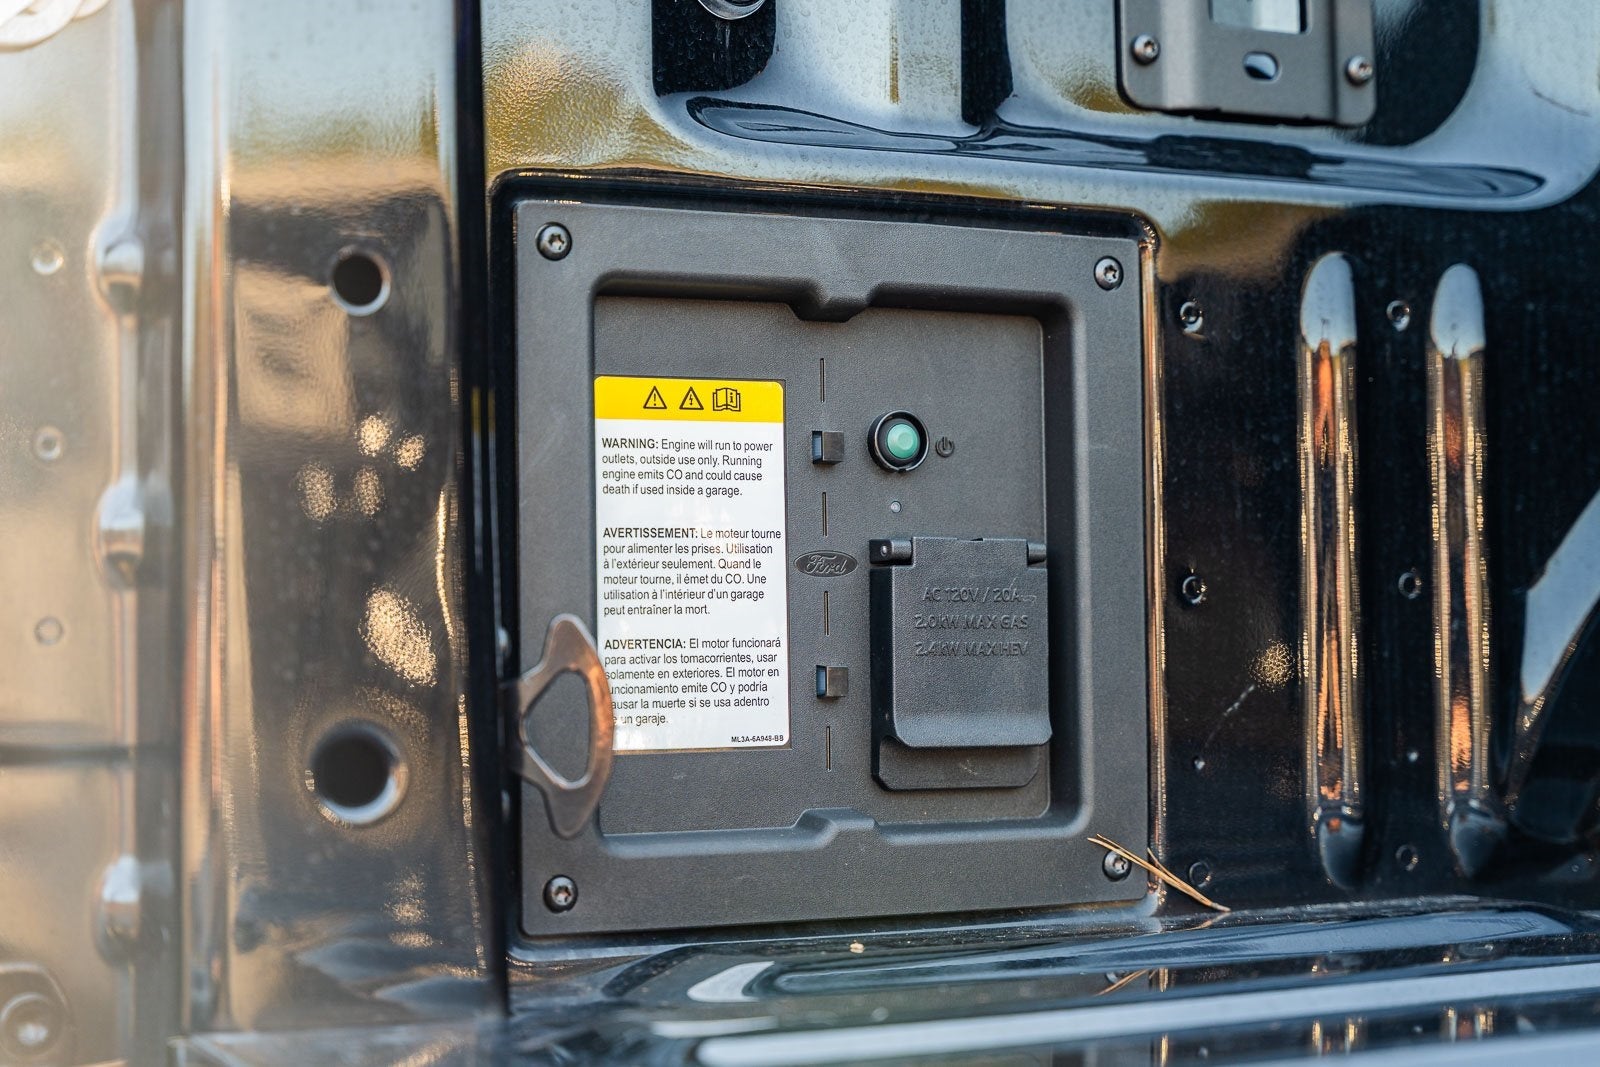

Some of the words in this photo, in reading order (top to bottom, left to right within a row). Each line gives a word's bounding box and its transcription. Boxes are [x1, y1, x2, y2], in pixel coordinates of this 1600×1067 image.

[602, 438, 658, 449] WARNING:
[662, 439, 695, 452] Engine
[698, 440, 712, 450] will
[733, 442, 742, 450] to
[744, 443, 773, 452] power
[602, 454, 638, 465] outlets,
[640, 454, 675, 464] outside
[678, 457, 695, 465] use
[698, 455, 720, 467] only.
[722, 456, 762, 468] Running
[602, 470, 635, 481] engine
[638, 469, 664, 480] emits
[666, 470, 682, 480] CO
[685, 470, 703, 480] and
[706, 470, 731, 480] could
[734, 472, 762, 481] cause
[603, 484, 630, 494] death
[632, 484, 638, 494] if
[641, 484, 664, 495] used
[666, 485, 694, 495] inside
[697, 487, 703, 495] a
[706, 487, 742, 498] garage.
[603, 528, 698, 538] AVERTISSEMENT:
[701, 528, 712, 538] Le
[715, 529, 749, 538] moteur
[752, 529, 781, 538] tourne
[603, 545, 625, 555] pour
[628, 544, 672, 554] alimenter
[675, 544, 689, 553] les
[692, 544, 723, 556] prises.
[726, 544, 772, 554] Utilisation
[604, 559, 609, 569] à
[662, 559, 715, 569] seulement.
[718, 559, 750, 569] Quand
[753, 559, 761, 569] le
[806, 554, 847, 575] Ford
[604, 575, 637, 584] moteur
[640, 575, 674, 586] tourne,
[676, 574, 681, 584] il
[684, 574, 708, 584] émet
[711, 574, 722, 584] du
[725, 574, 744, 584] CO.
[747, 574, 766, 584] Une
[604, 589, 649, 599] utilisation
[652, 589, 658, 599] à
[708, 589, 728, 599] d'un
[731, 590, 764, 601] garage
[922, 587, 940, 602] AC
[945, 587, 978, 602] 120V
[993, 588, 1020, 602] 20A
[604, 606, 625, 617] peut
[628, 604, 672, 615] entraîner
[674, 604, 682, 614] la
[685, 605, 710, 614] mort.
[963, 614, 997, 629] MAX
[1000, 615, 1029, 629] GAS
[605, 639, 685, 649] ADVERTENCIA:
[690, 638, 698, 648] El
[702, 639, 729, 648] motor
[732, 637, 781, 648] funcionará
[963, 641, 997, 656] MAX
[999, 641, 1029, 656] HEV
[605, 656, 626, 666] para
[629, 654, 660, 664] activar
[663, 654, 677, 664] los
[680, 653, 754, 664] tomacorrientes,
[756, 654, 777, 662] usar
[606, 670, 654, 679] solamente
[658, 670, 669, 678] en
[673, 668, 722, 678] exteriores.
[726, 667, 735, 677] El
[738, 668, 766, 677] motor
[768, 668, 779, 676] en
[610, 684, 678, 695] uncionamiento
[682, 683, 707, 693] emite
[710, 682, 726, 692] CO
[729, 684, 735, 694] y
[738, 681, 767, 693] podría
[612, 700, 637, 709] ausar
[641, 699, 649, 708] la
[652, 698, 685, 708] muerte
[689, 698, 697, 707] si
[714, 698, 731, 707] usa
[734, 696, 769, 706] adentro
[621, 714, 633, 724] un
[636, 713, 668, 726] garaje.
